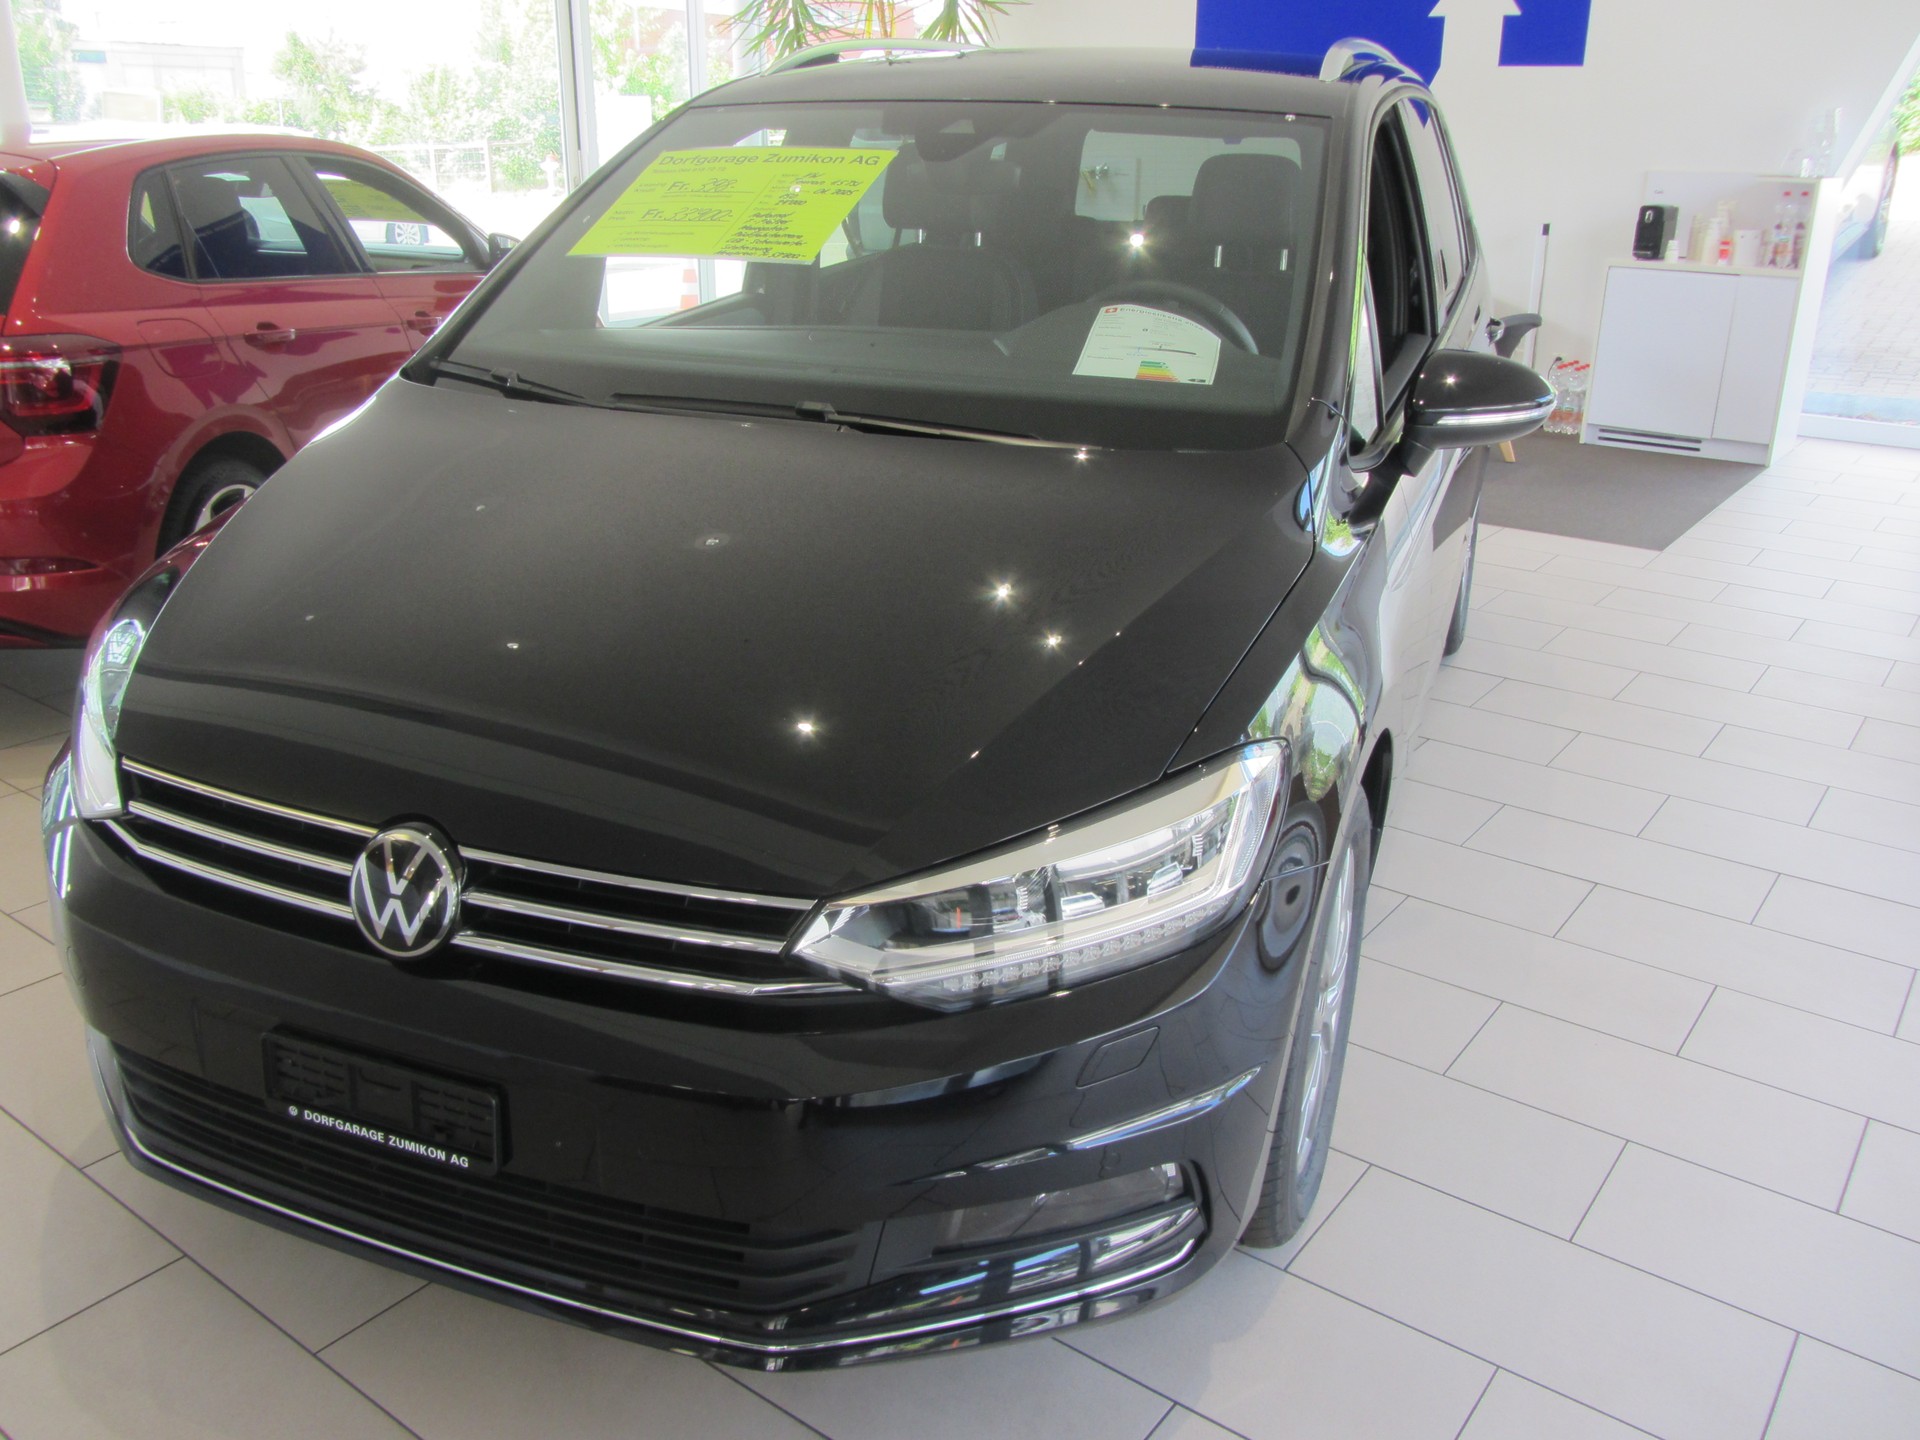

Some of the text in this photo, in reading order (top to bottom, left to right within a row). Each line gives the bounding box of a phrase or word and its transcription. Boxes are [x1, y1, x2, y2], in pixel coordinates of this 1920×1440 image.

[658, 153, 881, 166] Dorfgarage Zumikon AG
[667, 180, 690, 191] Fr.
[641, 208, 666, 220] Fr.
[303, 1109, 470, 1169] DORFGARAGE ZUMIKON AG
